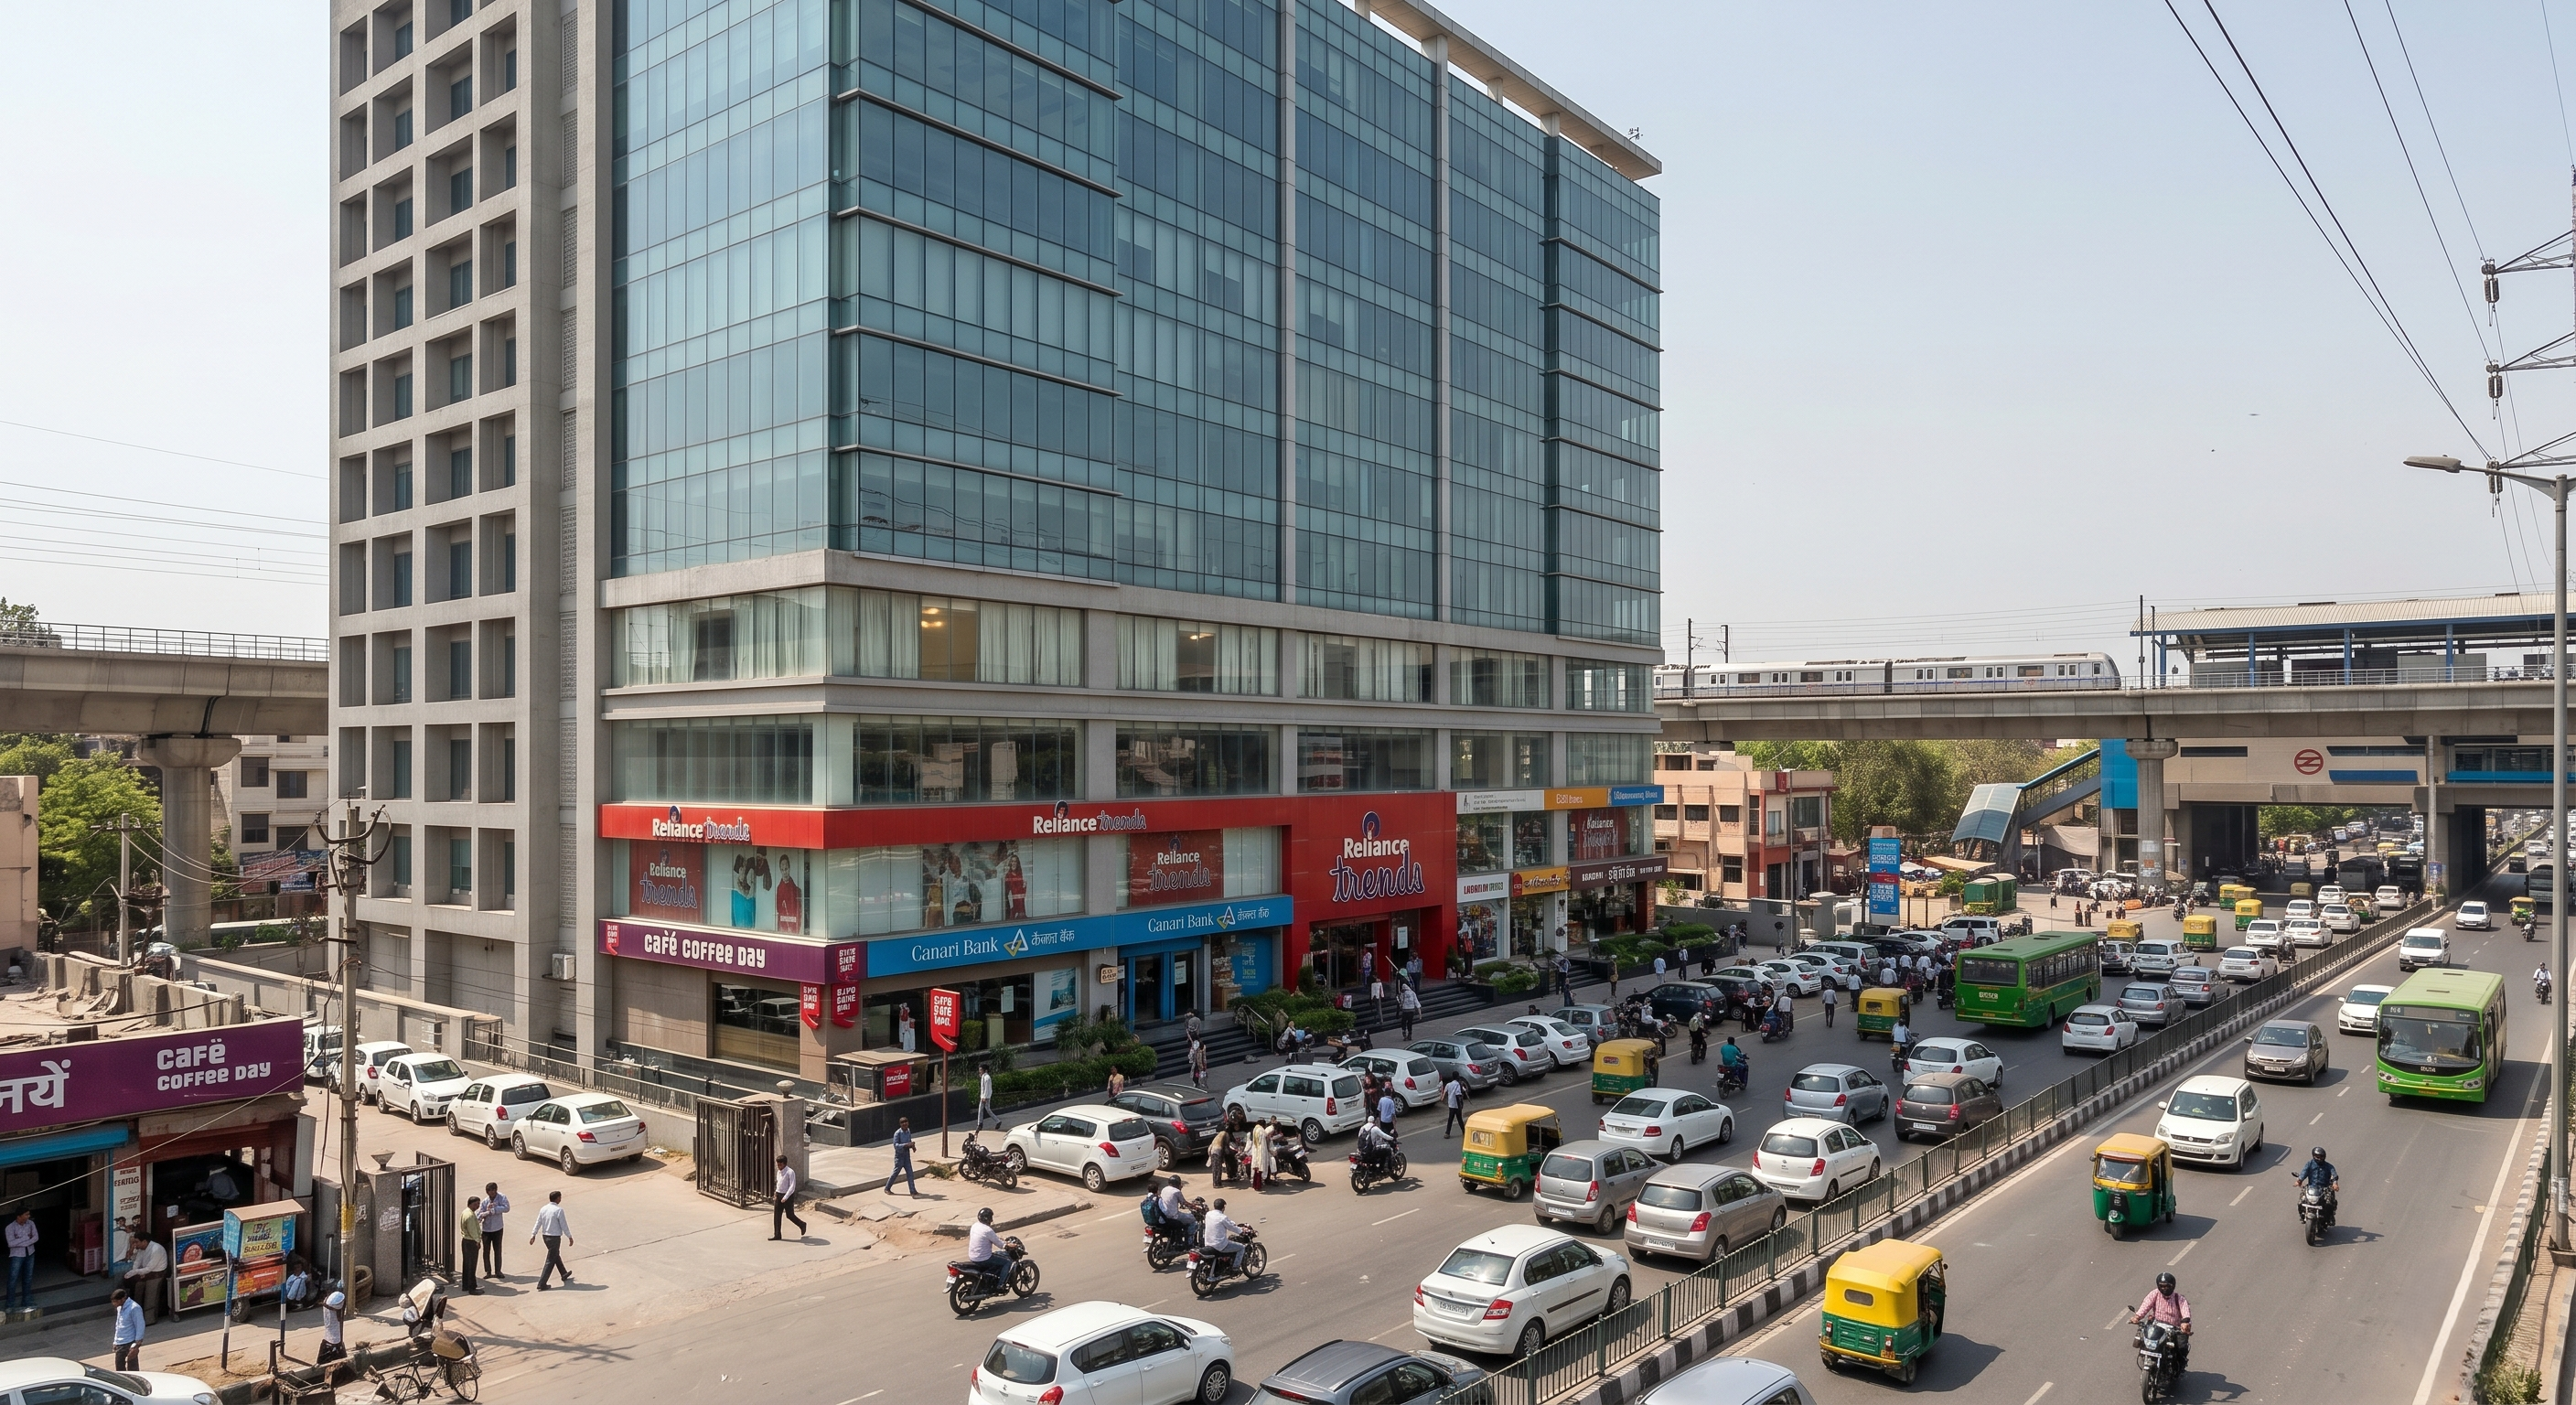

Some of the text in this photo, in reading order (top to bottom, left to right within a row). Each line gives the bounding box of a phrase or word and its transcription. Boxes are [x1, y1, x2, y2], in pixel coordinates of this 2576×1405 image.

[652, 818, 703, 839] Reliance
[1033, 816, 1097, 834] Reliance
[1344, 837, 1410, 859] Reliance
[1329, 847, 1424, 903] trends
[1148, 913, 1215, 933] Canari Bank
[911, 936, 999, 962] Canari Bank
